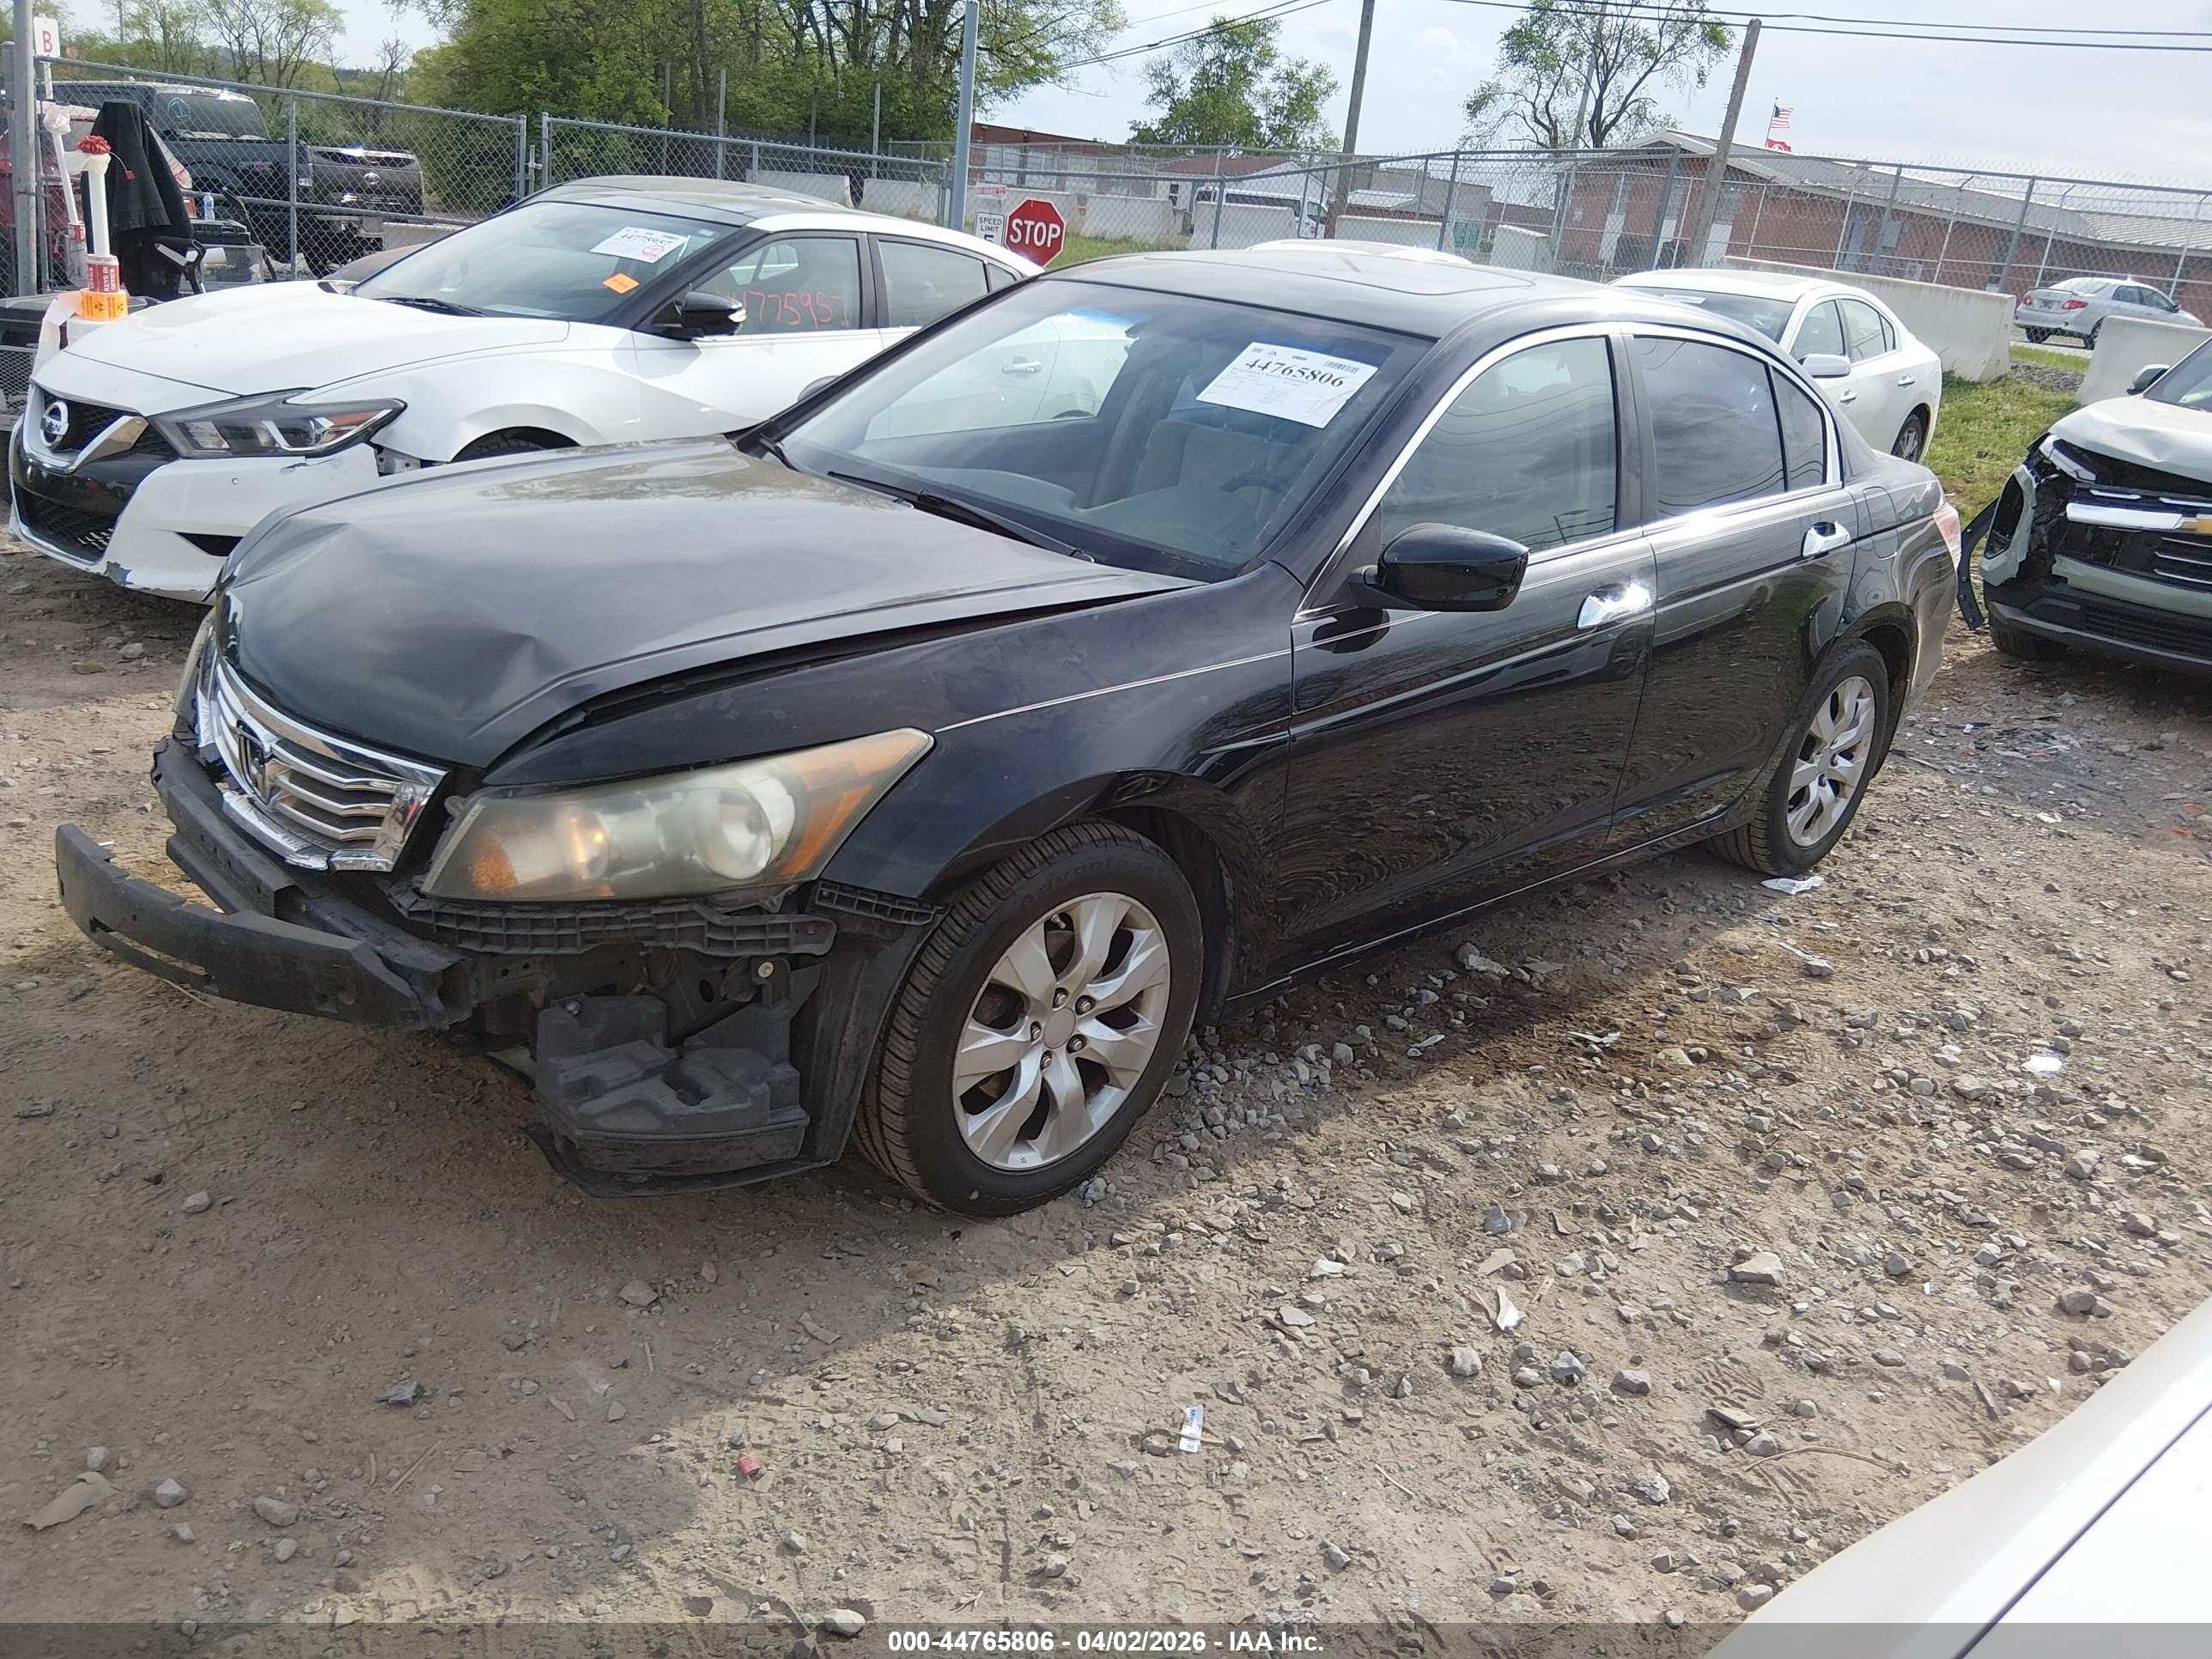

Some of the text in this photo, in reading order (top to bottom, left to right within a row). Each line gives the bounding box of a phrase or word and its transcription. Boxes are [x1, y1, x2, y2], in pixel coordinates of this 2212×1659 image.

[42, 30, 53, 52] B
[979, 216, 1002, 225] SPEED
[1009, 218, 1060, 247] STOP
[1245, 358, 1346, 387] 44765806
